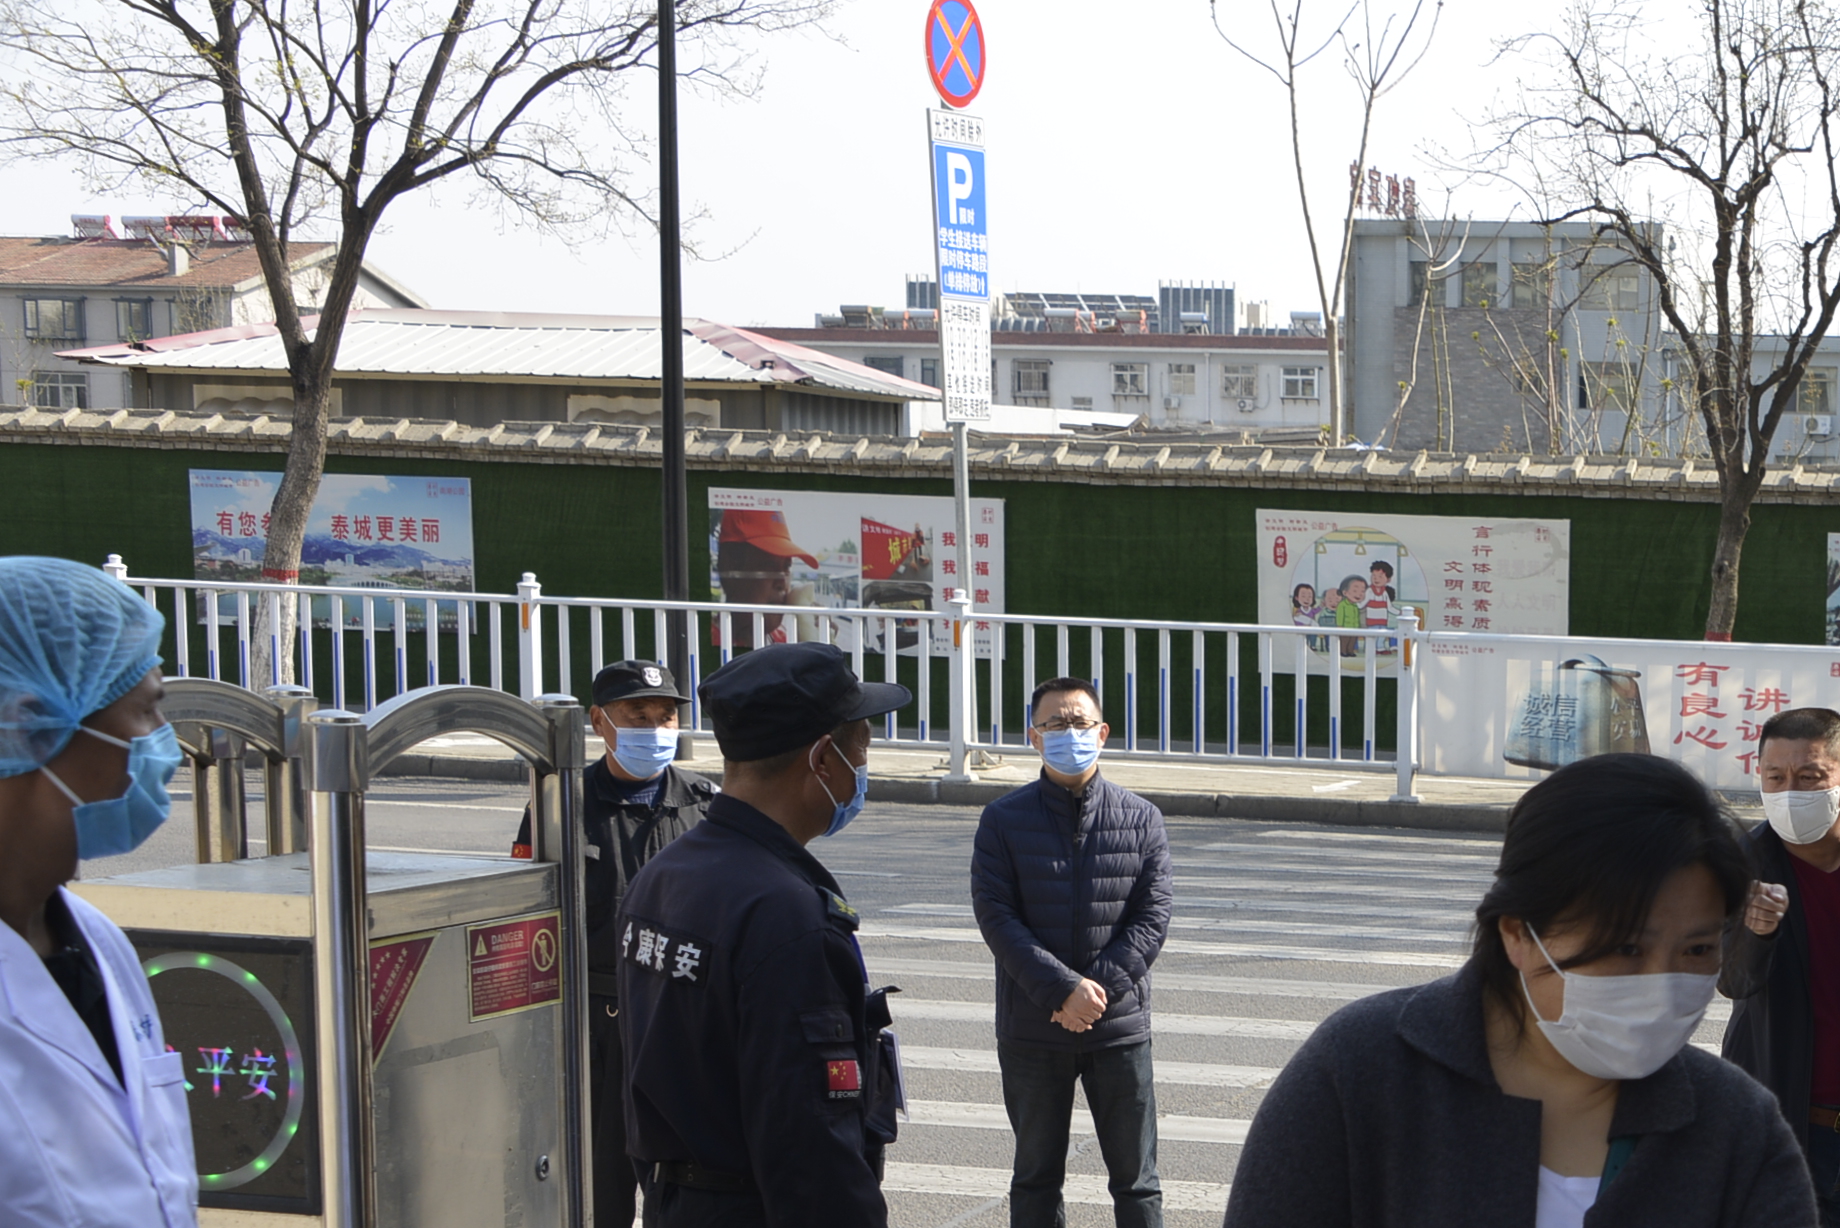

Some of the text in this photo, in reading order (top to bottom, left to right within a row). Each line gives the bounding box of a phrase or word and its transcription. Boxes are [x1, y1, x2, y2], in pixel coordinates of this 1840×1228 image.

[947, 151, 974, 224] P
[331, 514, 440, 543] 泰城更美丽
[1443, 561, 1464, 628] 文明赢得
[1472, 526, 1494, 629] 言行体现素质
[1520, 716, 1577, 742] 经营
[1522, 694, 1578, 718] 诚信
[1673, 662, 1730, 750] 有良心
[491, 931, 524, 945] DANGER
